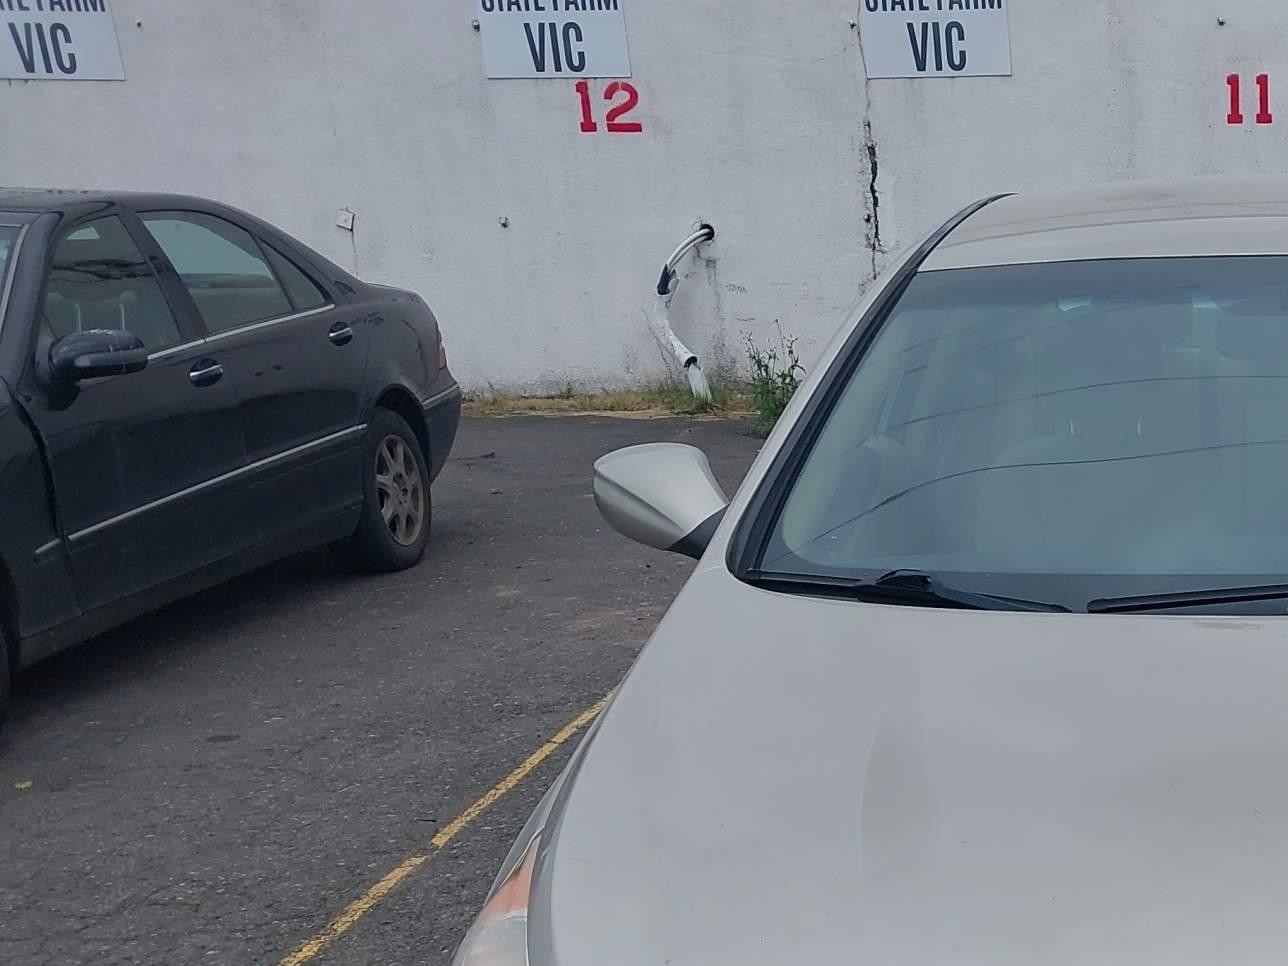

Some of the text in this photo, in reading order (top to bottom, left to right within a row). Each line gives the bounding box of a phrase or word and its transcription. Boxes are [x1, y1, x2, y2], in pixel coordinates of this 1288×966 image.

[8, 22, 77, 74] VIC
[523, 21, 586, 72] VIC
[906, 21, 967, 72] VIC
[575, 81, 643, 133] 12
[1226, 73, 1273, 124] 11
